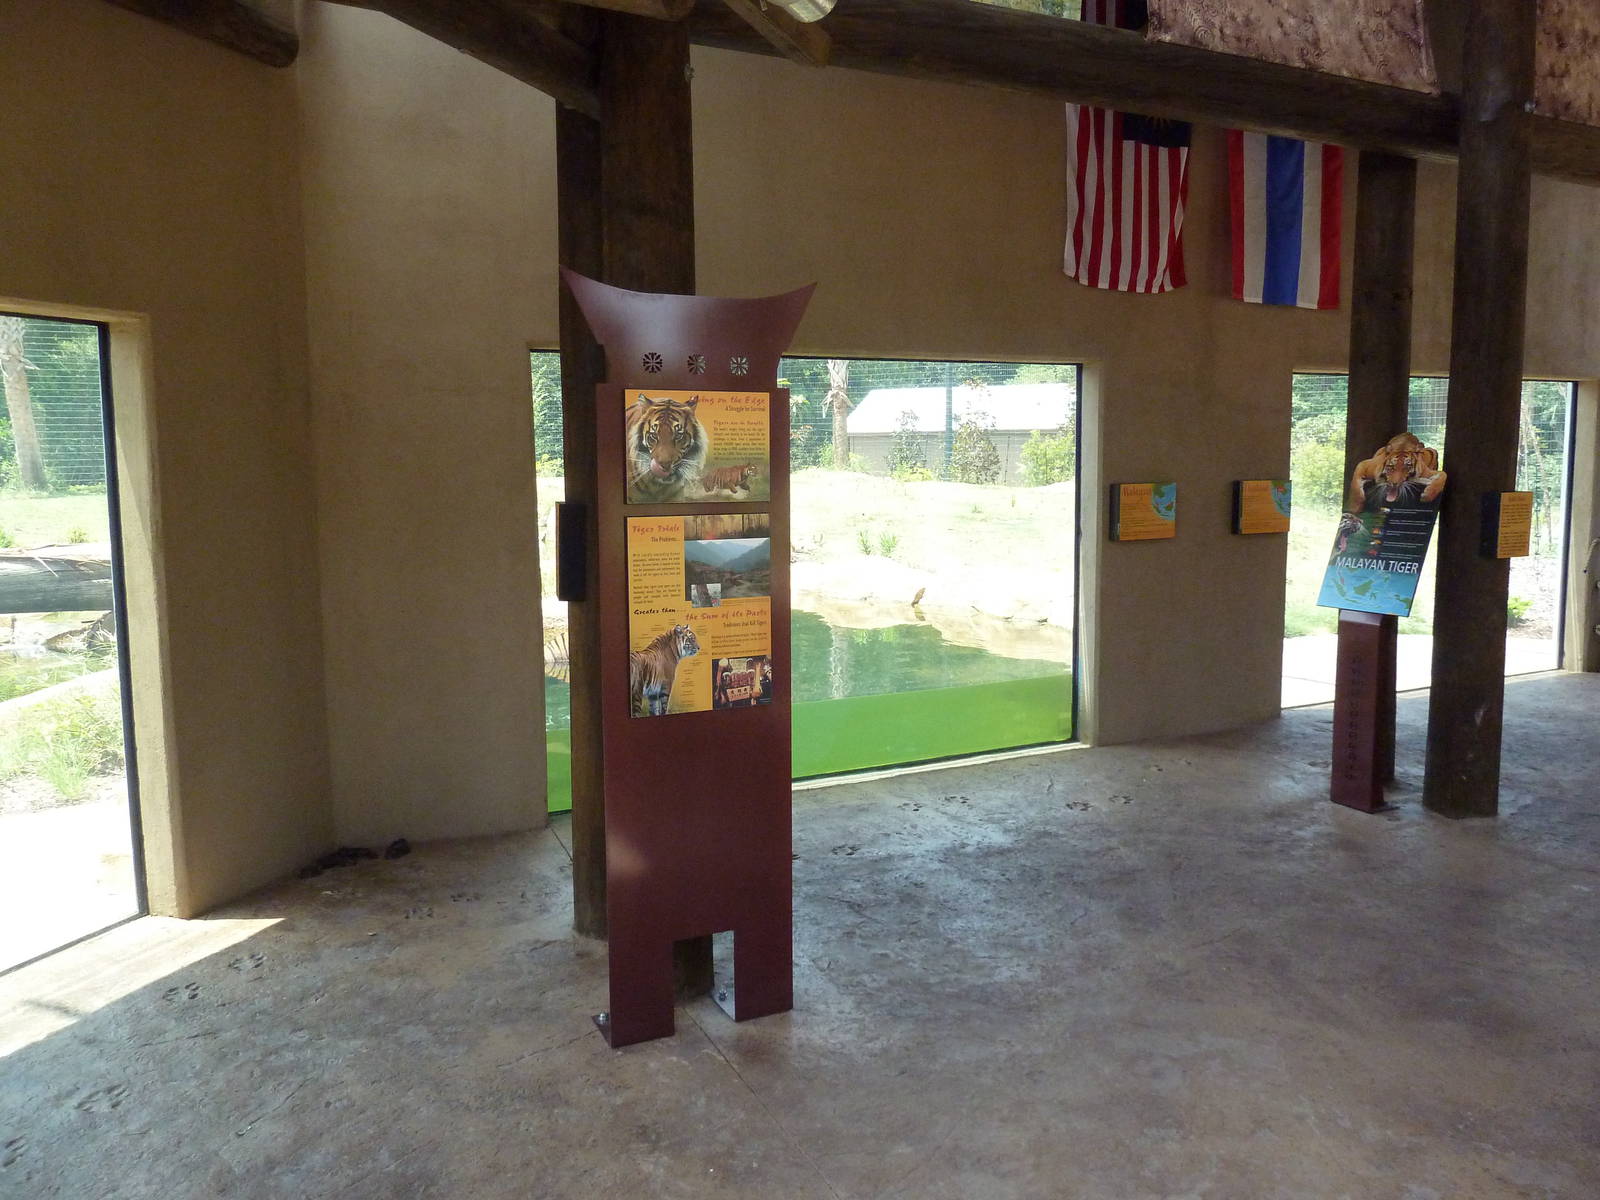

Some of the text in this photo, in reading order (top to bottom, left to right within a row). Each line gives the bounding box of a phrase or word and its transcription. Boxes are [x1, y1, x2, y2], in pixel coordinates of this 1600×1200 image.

[632, 525, 654, 535] Tiger
[1335, 556, 1419, 574] MALAYAN TIGER
[685, 613, 697, 621] the
